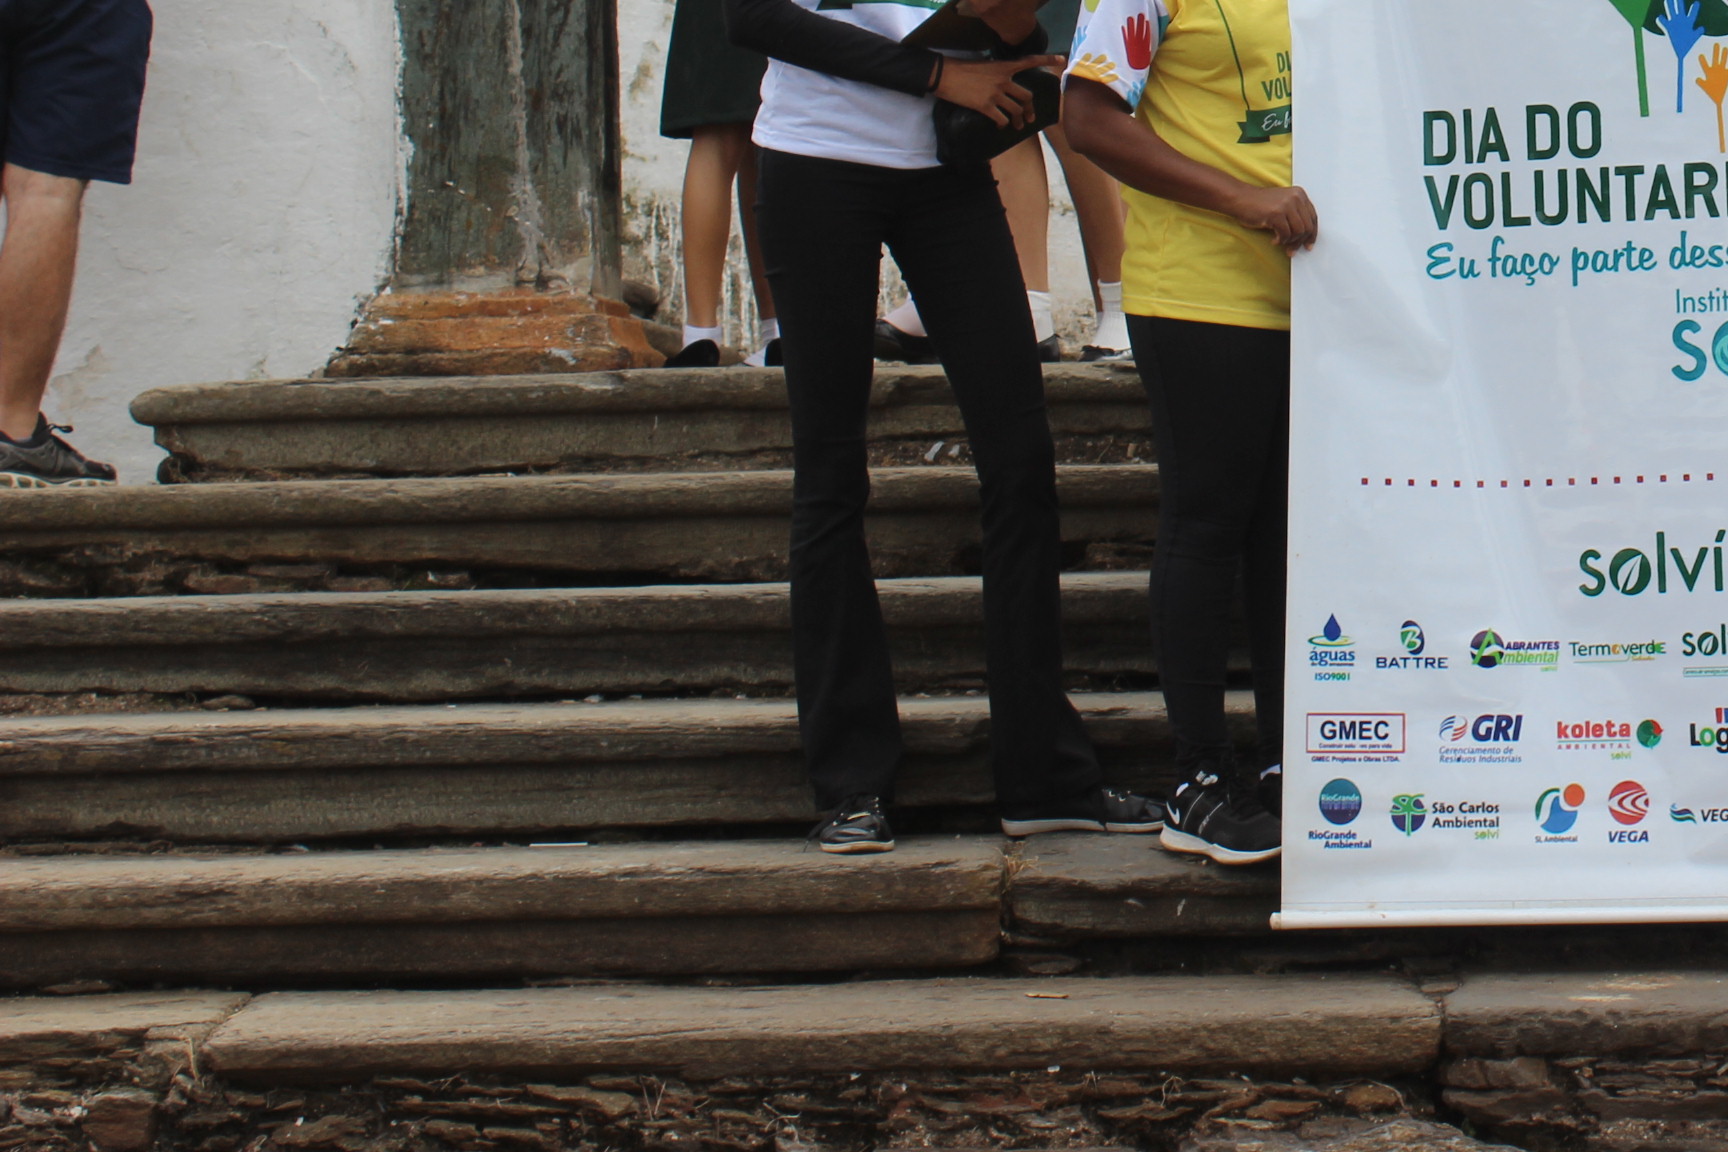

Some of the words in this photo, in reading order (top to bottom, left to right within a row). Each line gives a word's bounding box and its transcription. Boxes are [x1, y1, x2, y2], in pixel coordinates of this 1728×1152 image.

[1262, 113, 1283, 131] Eu
[1423, 107, 1510, 166] DIA
[1525, 101, 1602, 160] DO
[1426, 241, 1480, 279] Eu
[1488, 235, 1560, 285] faço
[1572, 240, 1657, 286] parte
[1578, 529, 1726, 596] solví
[1504, 641, 1560, 650] ABRANTES
[1309, 646, 1355, 667] águas
[1376, 656, 1449, 669] BATTRE
[1314, 672, 1351, 681] ISO9001
[1320, 720, 1390, 741] GMEC
[1471, 714, 1523, 742] GRI
[1557, 720, 1631, 739] koleta
[1439, 745, 1501, 756] Gerenciamento
[1503, 746, 1514, 755] de
[1557, 742, 1631, 750] AMBIENTAL
[1479, 754, 1522, 763] Industriais
[1432, 801, 1454, 814] São
[1459, 801, 1500, 814] Carlos
[1432, 815, 1500, 828] Ambiental
[1308, 830, 1357, 840] RioGrande
[1544, 835, 1578, 843] Ambiental
[1608, 830, 1649, 842] VEGA
[1324, 839, 1372, 848] Ambiental
